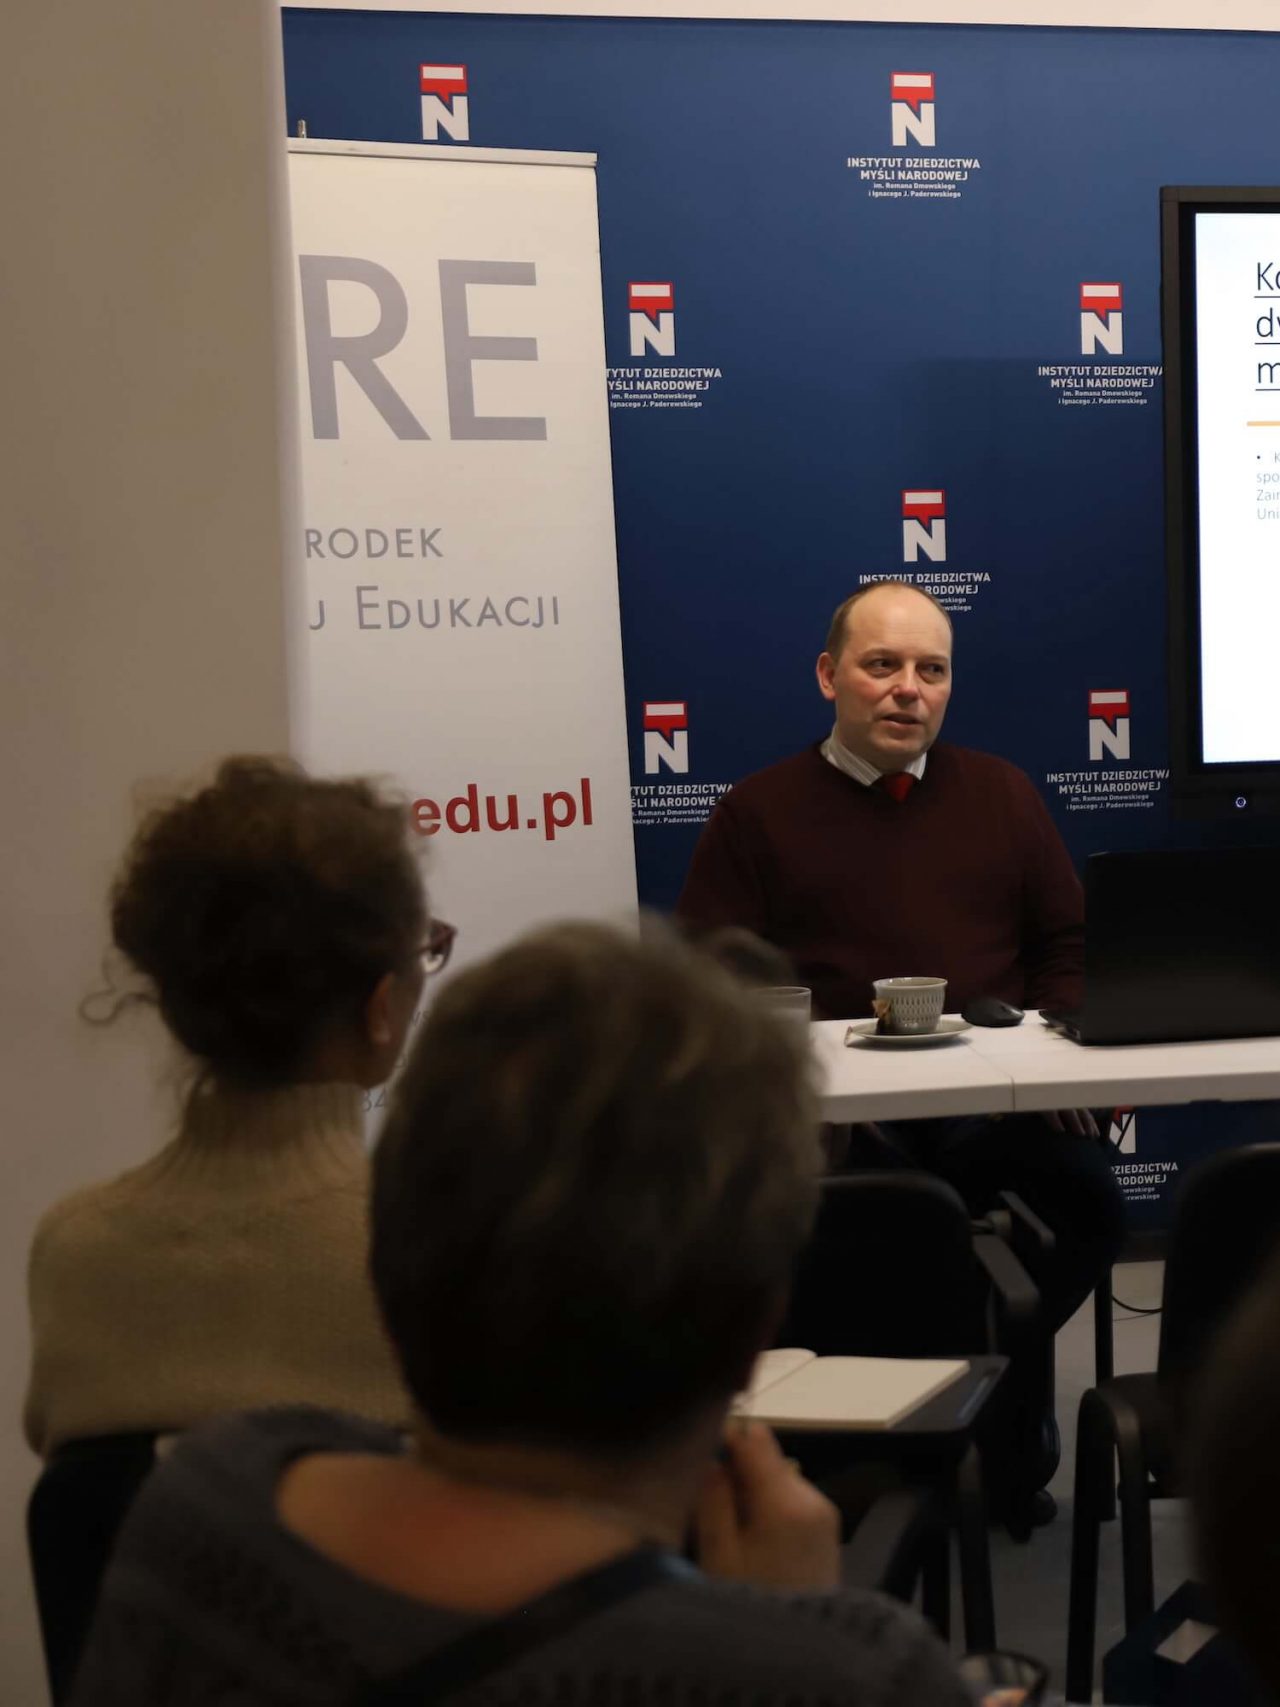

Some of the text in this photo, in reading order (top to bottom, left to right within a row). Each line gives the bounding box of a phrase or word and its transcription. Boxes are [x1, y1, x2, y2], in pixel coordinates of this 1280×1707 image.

[847, 157, 981, 169] INSTYTUT DZIEDZICTWA
[860, 168, 968, 181] MYŚLI NARODOWEJ
[873, 182, 956, 191] im. Romana Dmowskiego
[872, 190, 902, 199] Ignacego
[911, 191, 962, 199] Paderewskiego
[606, 368, 722, 378] TYTUT DZIEDZICTWA
[1038, 366, 1092, 376] INSTYTUT
[607, 378, 710, 391] YŚLI NARODOWEJ
[1051, 376, 1155, 388] MYŚLI NARODOWEJ
[653, 392, 697, 401] Dmowskiego
[305, 528, 444, 559] RODEK
[917, 573, 991, 583] DZIEDZICTWA
[925, 585, 979, 595] RODOWEJ
[1047, 771, 1100, 783] INSTYTUT
[1058, 781, 1161, 795] MYŚLI NARODOWEJ
[650, 796, 721, 808] NARODOWE
[411, 778, 593, 841] edu.pl
[1110, 1162, 1179, 1175] ZIEDZICTWA
